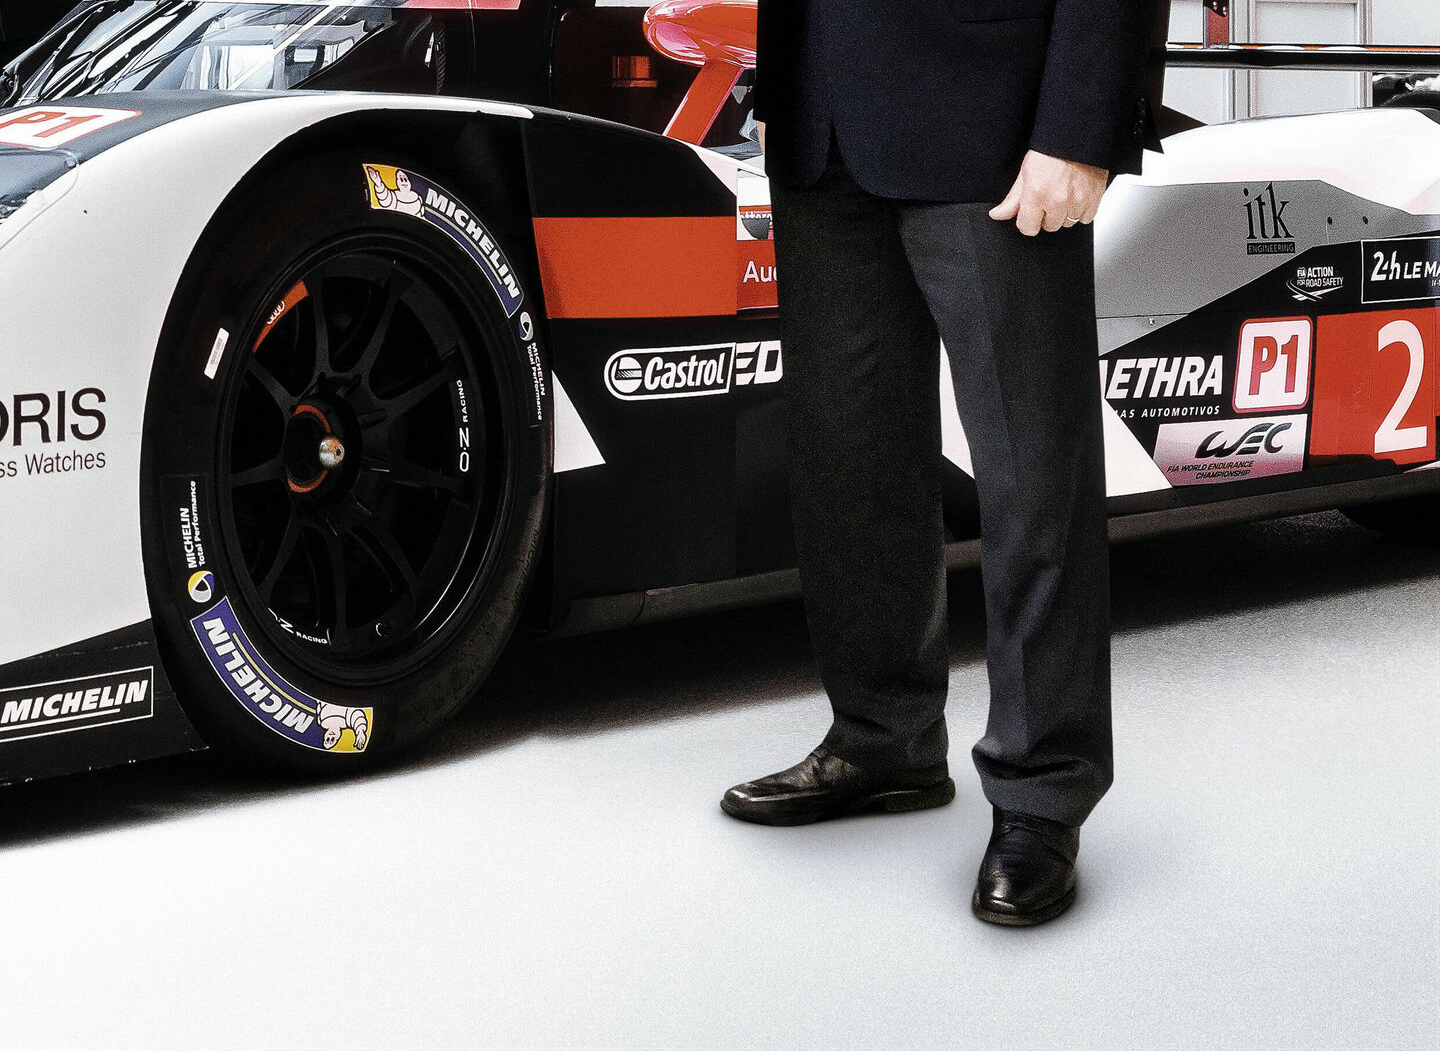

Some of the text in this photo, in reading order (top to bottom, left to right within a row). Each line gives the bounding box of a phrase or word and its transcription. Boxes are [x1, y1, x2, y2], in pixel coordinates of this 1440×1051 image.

[1243, 181, 1295, 240] itk
[425, 188, 520, 299] MICHELIN
[1248, 243, 1294, 253] ENGINEERING
[1306, 278, 1322, 287] ROAD
[1322, 277, 1344, 286] SAFETY
[1307, 266, 1334, 278] ACTION
[1403, 261, 1422, 279] LE
[531, 342, 546, 396] MICHELIN
[644, 353, 726, 391] Castrol
[1248, 334, 1299, 396] P1
[456, 379, 468, 423] RACING
[1374, 319, 1427, 455] 2
[1141, 405, 1220, 418] AUTOMOTIVOS
[1195, 422, 1293, 459] WEC
[24, 450, 106, 476] Watches
[1166, 460, 1255, 473] FIA WORLD ENDURANCE
[1195, 469, 1251, 480] CHAMPIONSHIP
[180, 507, 198, 569] MICHELIN
[190, 480, 206, 567] Total Performance
[296, 630, 328, 645] RACING
[202, 617, 315, 734] MICHELIN
[0, 679, 149, 724] MICHELIN
